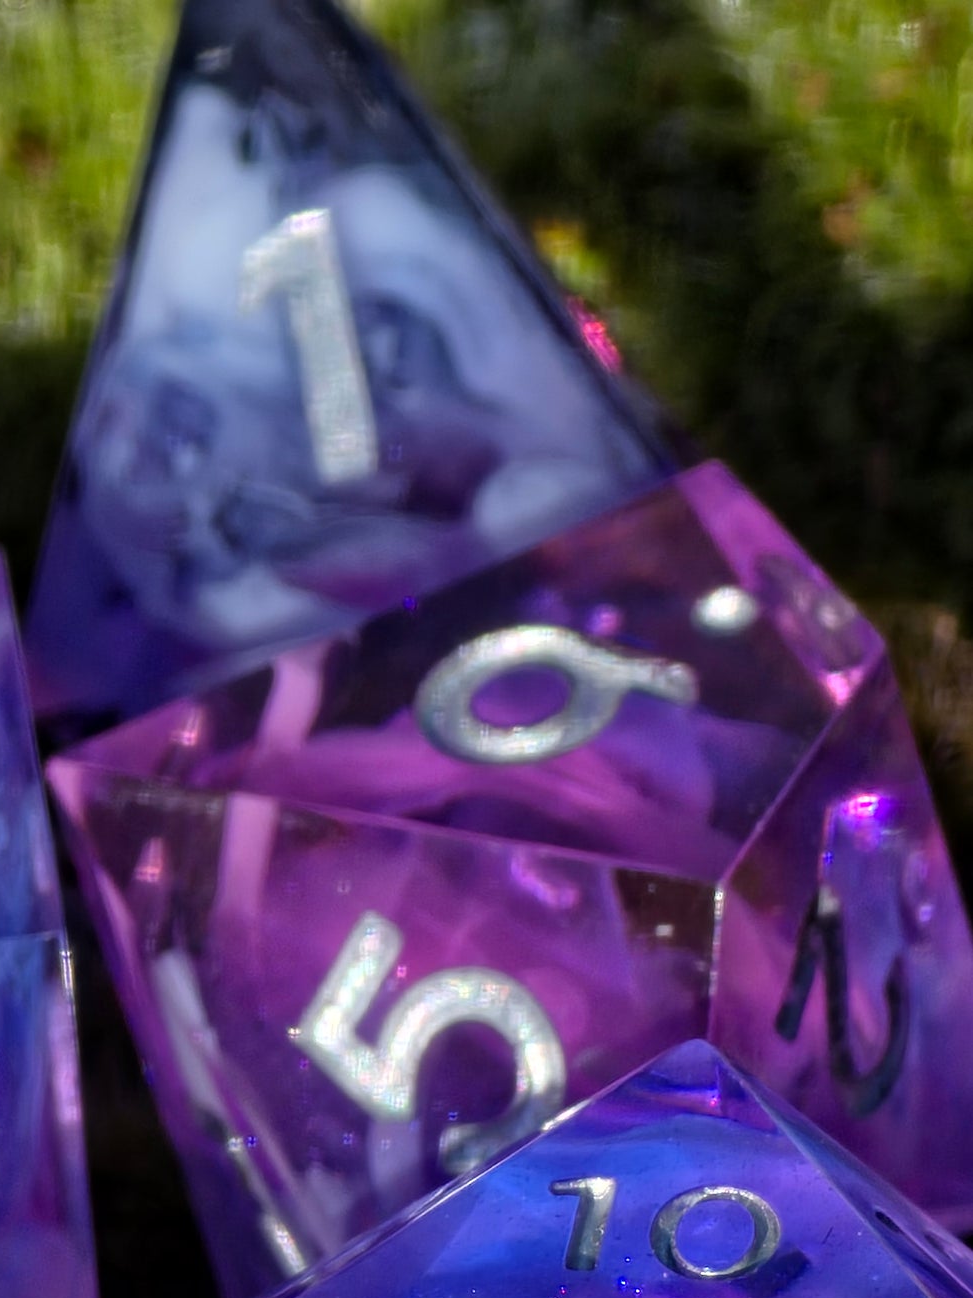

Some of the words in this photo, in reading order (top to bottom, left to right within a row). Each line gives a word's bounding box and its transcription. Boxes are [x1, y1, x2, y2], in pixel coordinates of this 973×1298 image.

[236, 206, 379, 485] 1
[289, 908, 567, 1176] 5
[548, 1176, 782, 1281] 10
